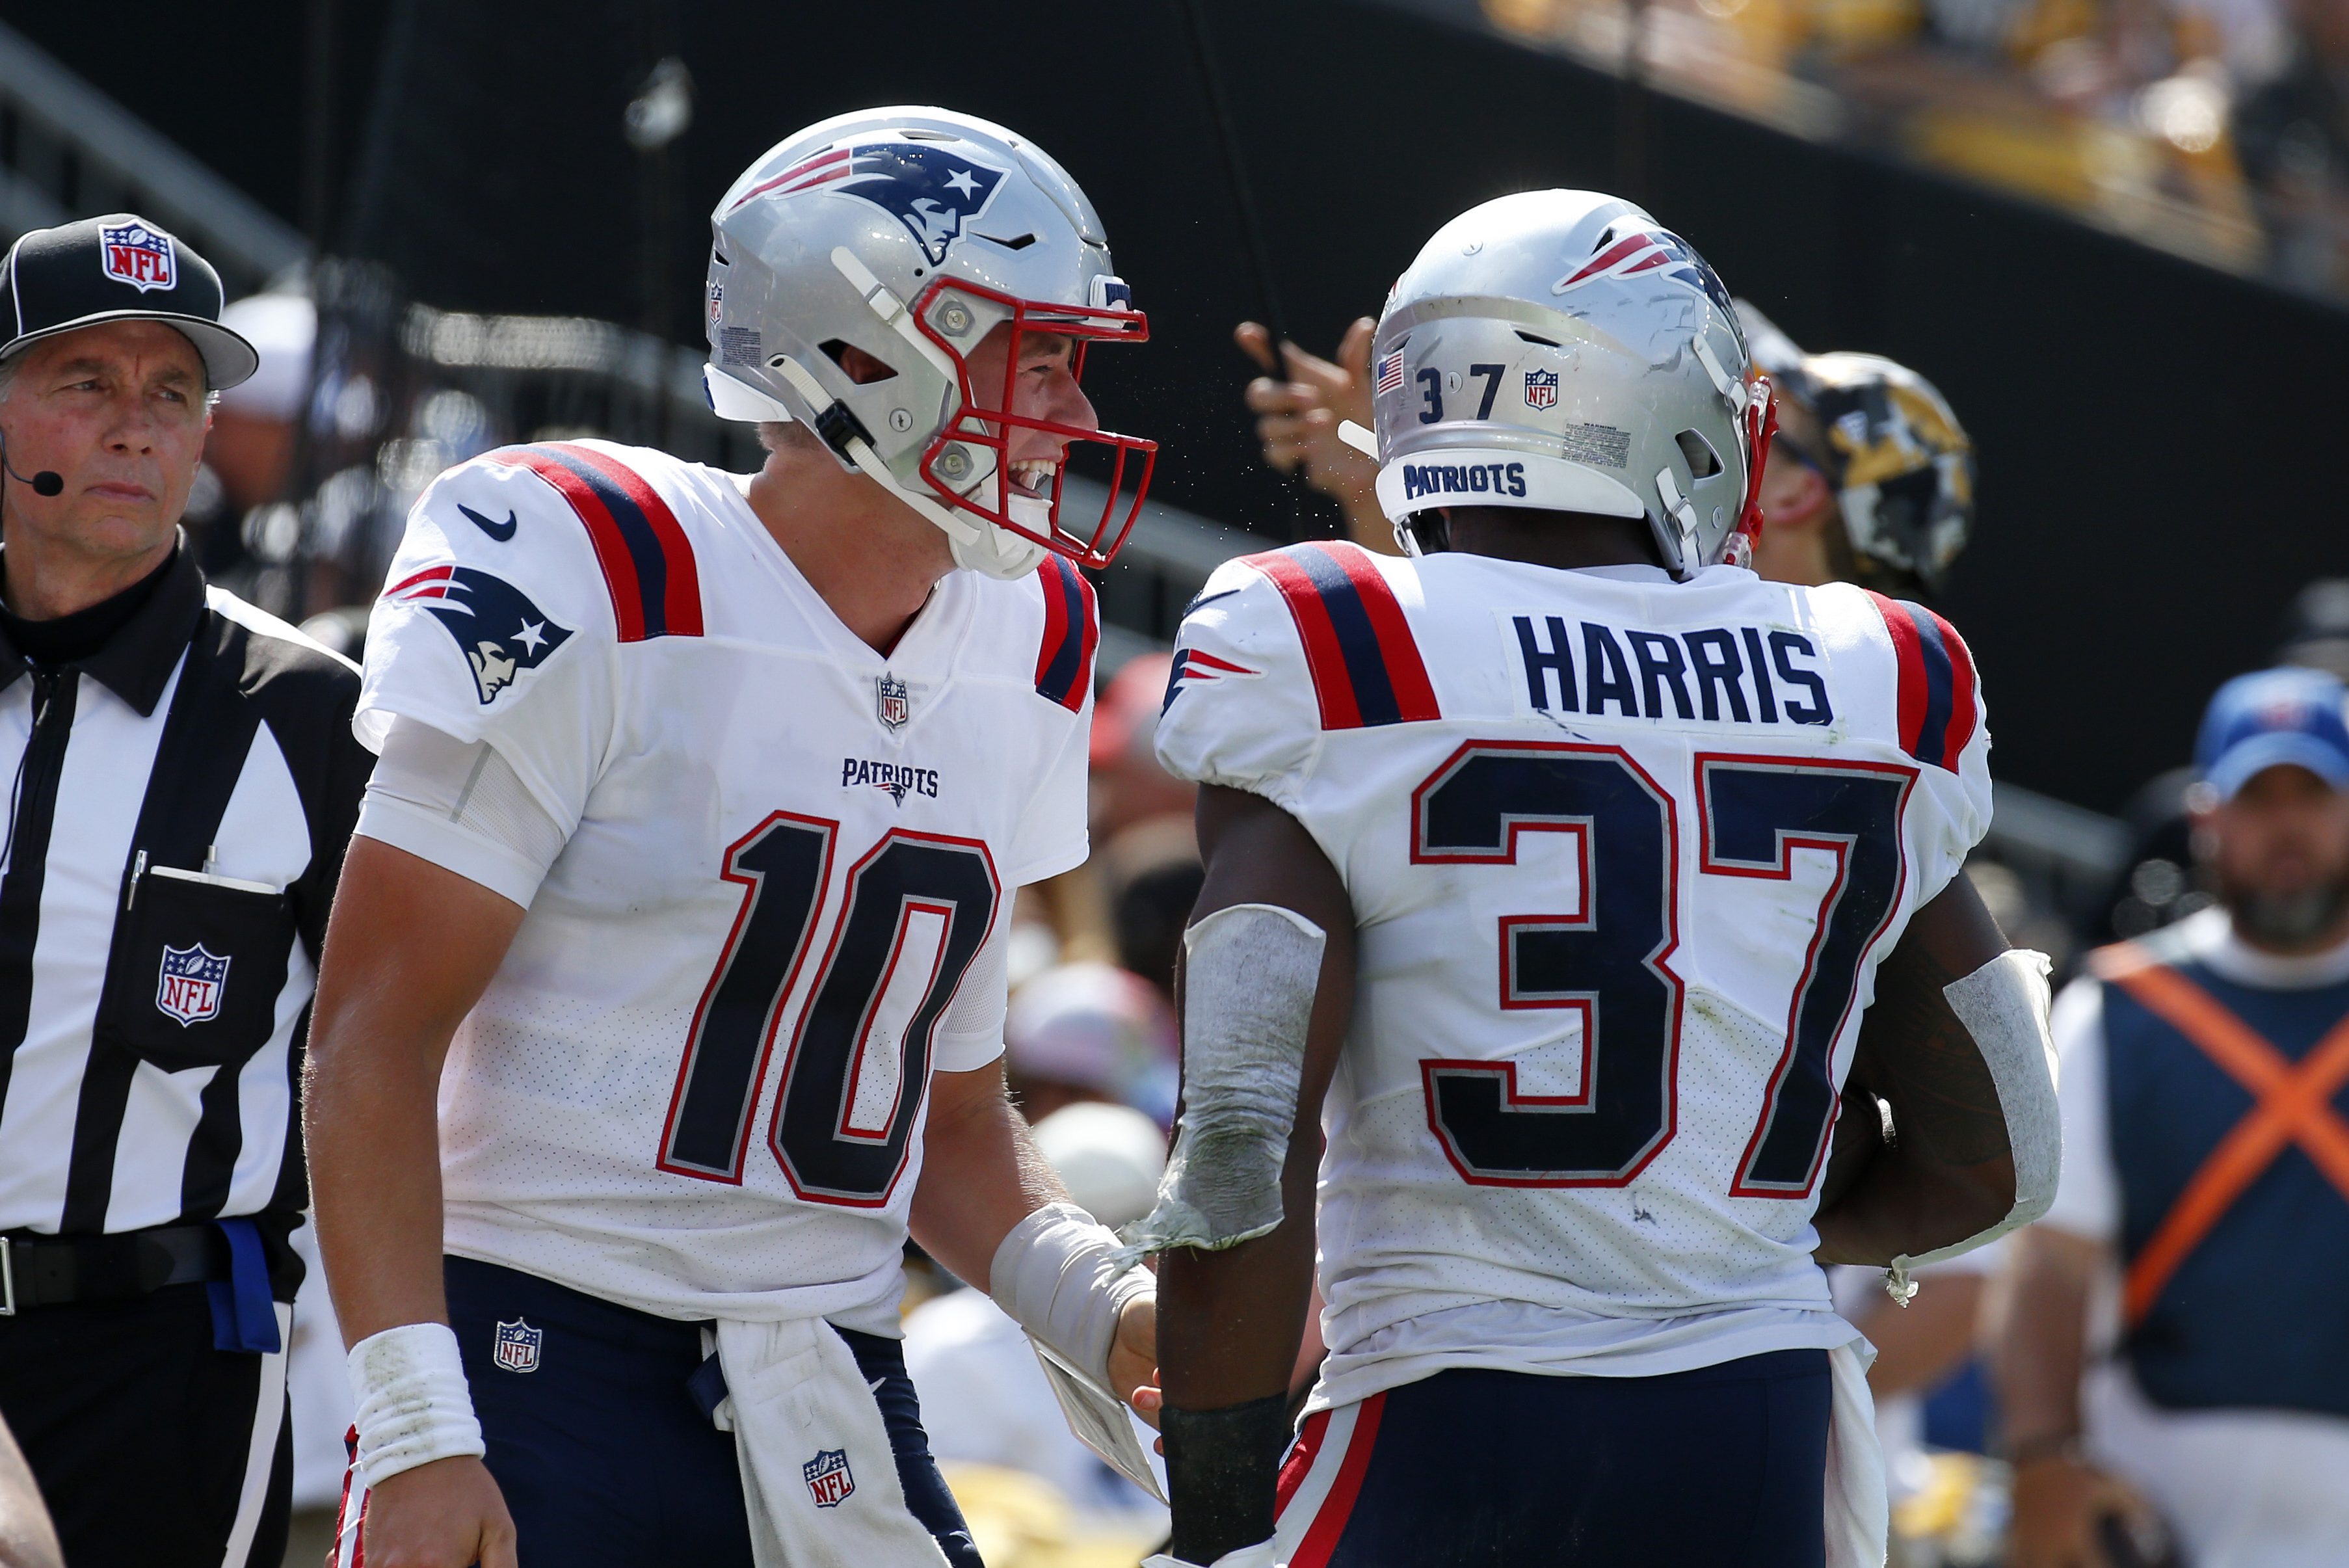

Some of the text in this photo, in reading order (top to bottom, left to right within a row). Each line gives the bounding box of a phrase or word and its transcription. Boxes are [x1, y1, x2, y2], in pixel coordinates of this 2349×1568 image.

[110, 247, 168, 282] NFL
[1528, 386, 1555, 406] NFL
[1403, 462, 1527, 500] PATRIOTS
[1512, 615, 1833, 726] HARRIS
[884, 697, 907, 721] NFL
[842, 758, 938, 799] PATRIOTS
[1410, 739, 1921, 1200] 37
[163, 976, 213, 1015] NFL
[656, 810, 1002, 1208] 10
[501, 1342, 533, 1366] NFL
[810, 1470, 853, 1504] NFL
